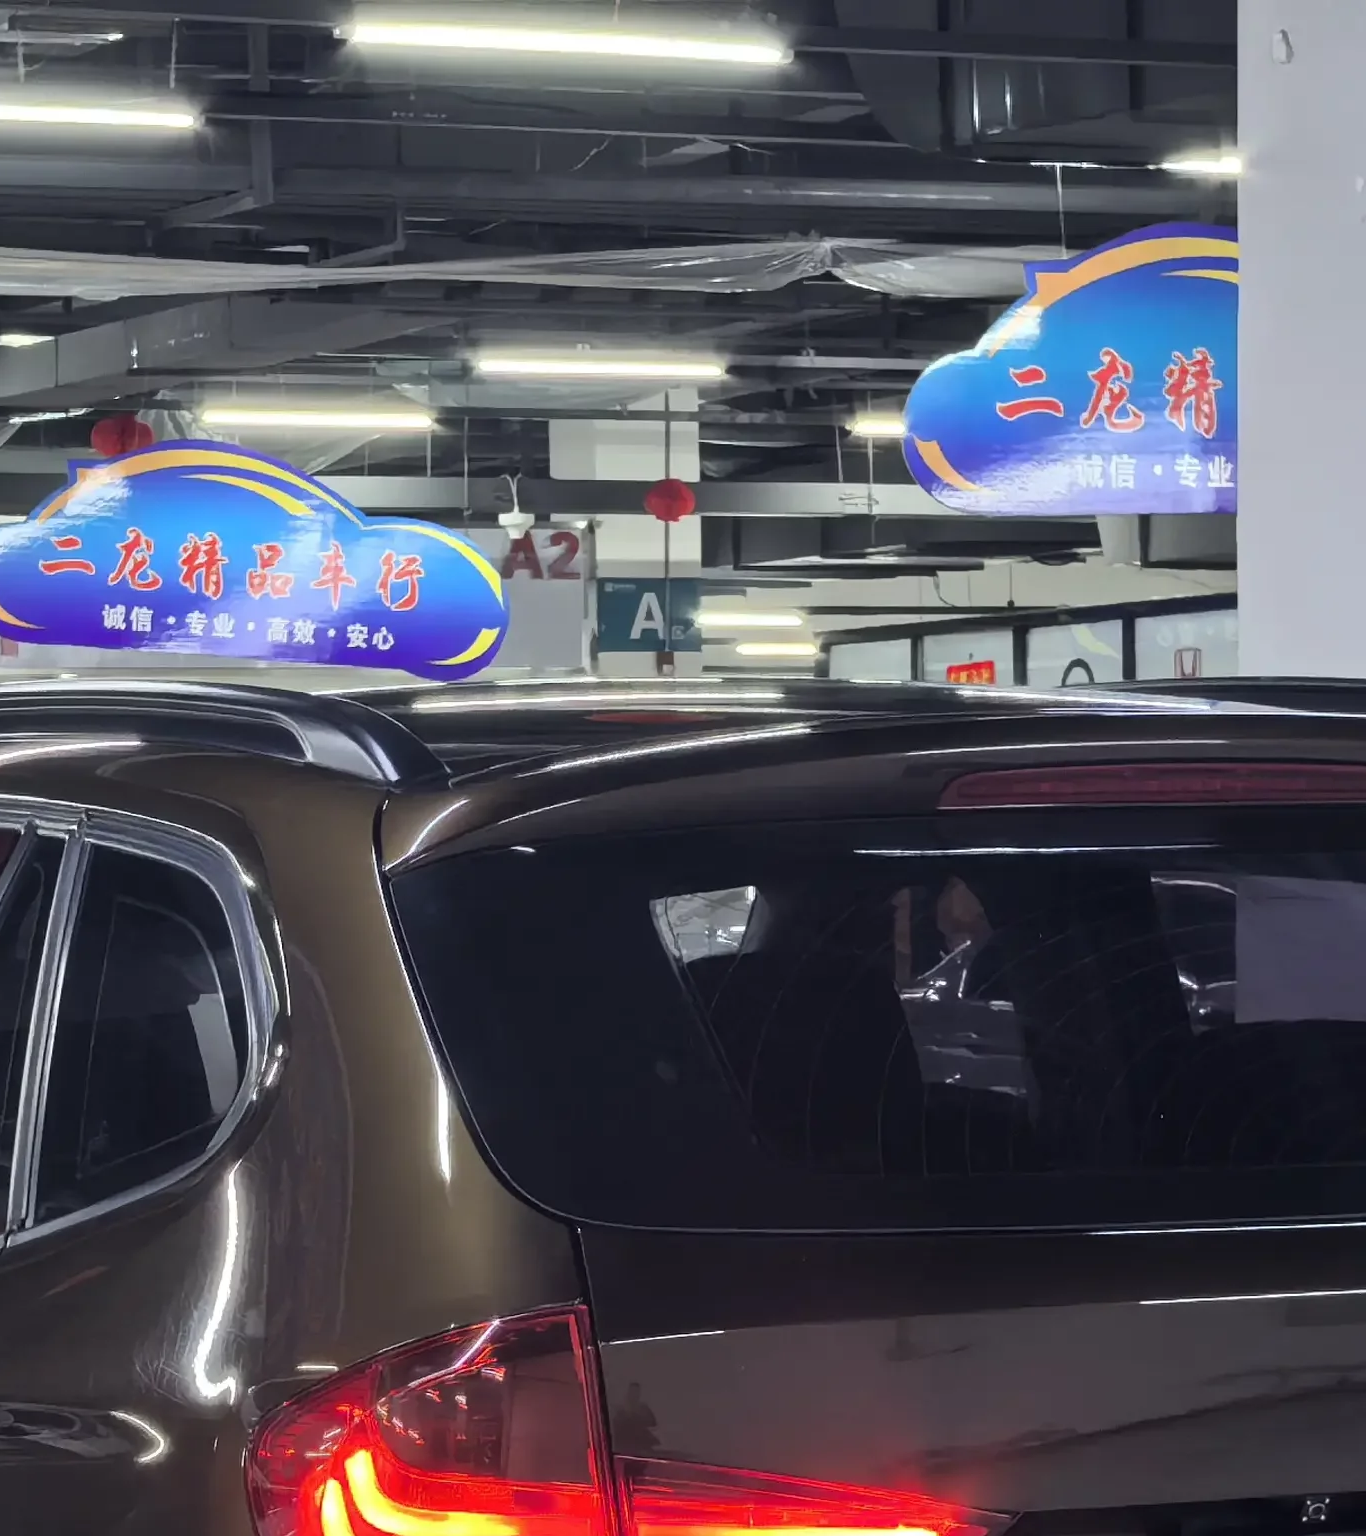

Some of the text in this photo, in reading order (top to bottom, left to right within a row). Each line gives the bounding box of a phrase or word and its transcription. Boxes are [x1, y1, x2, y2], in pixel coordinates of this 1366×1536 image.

[996, 347, 1224, 439] 二龙精
[502, 530, 581, 580] A2
